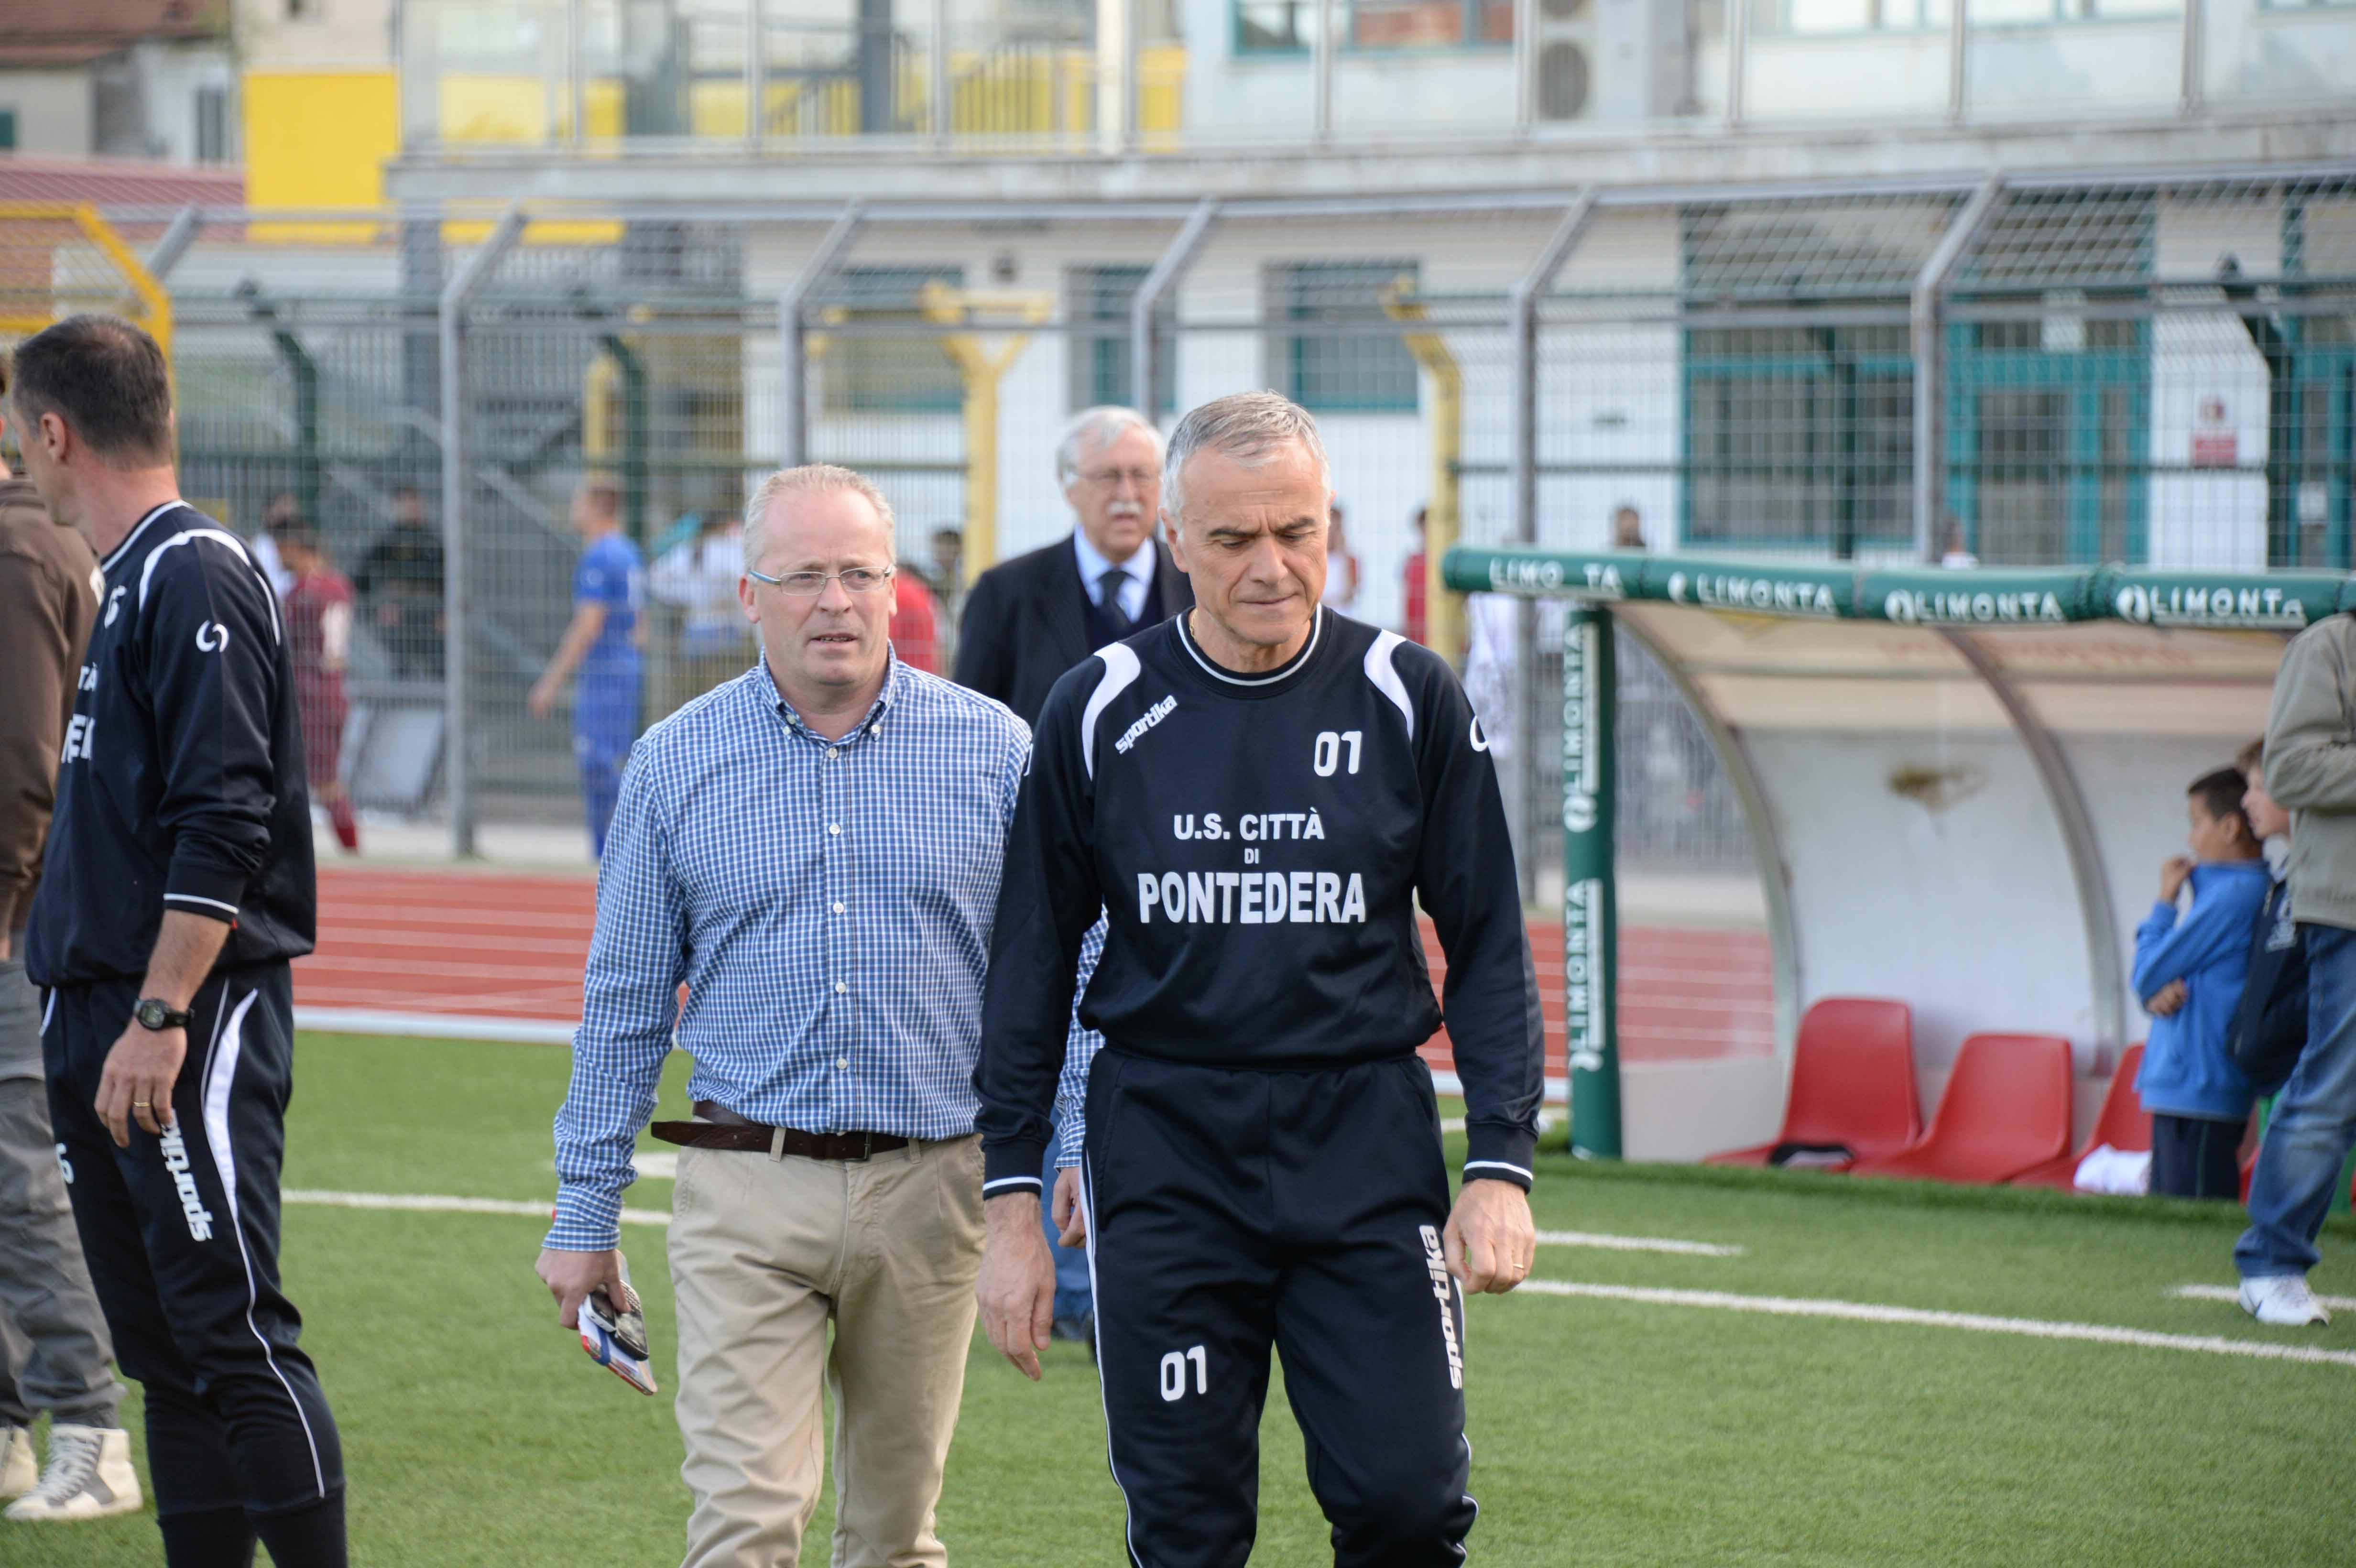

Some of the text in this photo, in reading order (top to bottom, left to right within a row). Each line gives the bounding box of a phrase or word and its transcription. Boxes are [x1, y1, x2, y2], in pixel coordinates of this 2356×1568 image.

[1697, 572, 1837, 614] LIMONTA
[1914, 590, 2067, 623] LIMONTA
[2151, 585, 2306, 621] LIMONTA
[1115, 695, 1178, 755] sportika
[1562, 621, 1582, 794] LIMONTA
[1313, 730, 1363, 777] 01
[1173, 806, 1325, 841] U.S. CITTÀ
[1243, 848, 1260, 864] DI
[1137, 871, 1367, 924] PONTEDERA
[1566, 878, 1589, 1053] LIMONTA
[1418, 1225, 1463, 1390] sportika
[1160, 1345, 1208, 1402] 01
